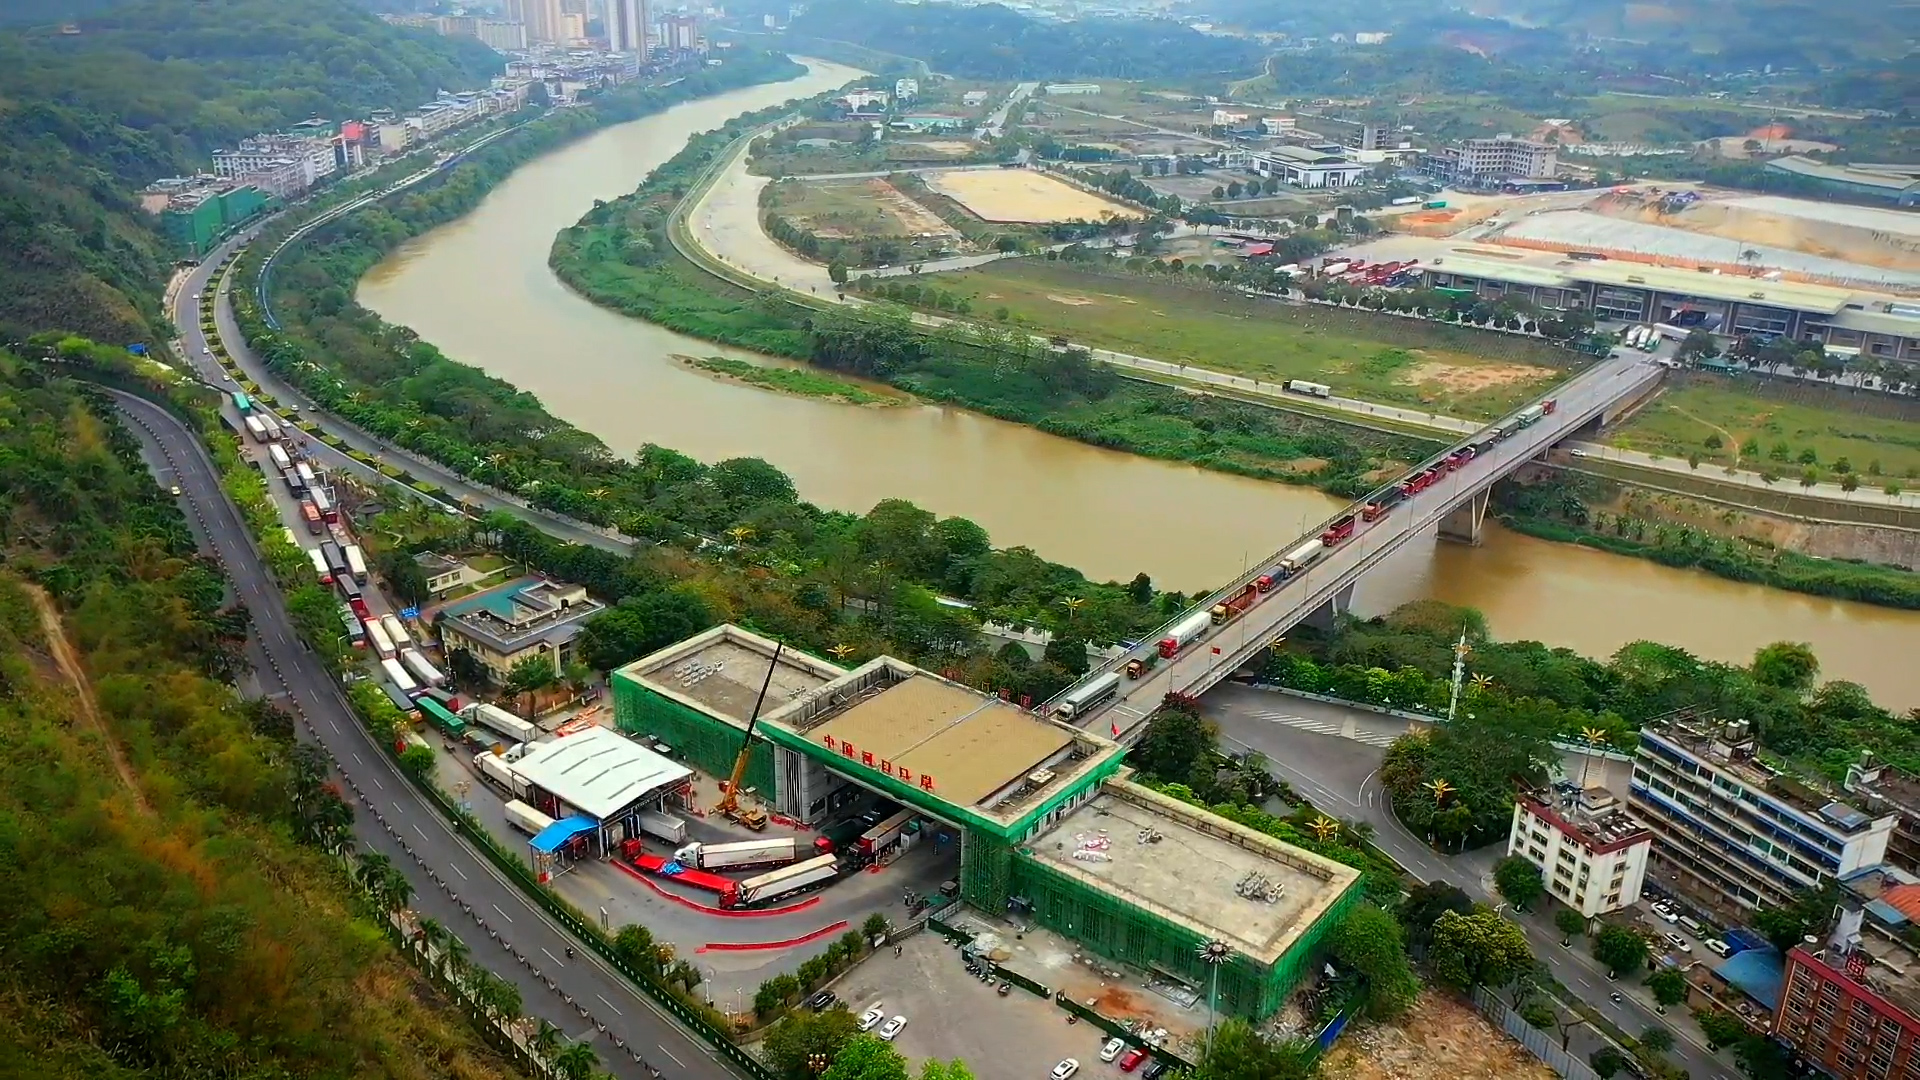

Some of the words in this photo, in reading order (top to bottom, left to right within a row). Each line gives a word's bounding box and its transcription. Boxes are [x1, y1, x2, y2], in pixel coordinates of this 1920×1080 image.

[824, 734, 933, 790] 中国河口口岸
